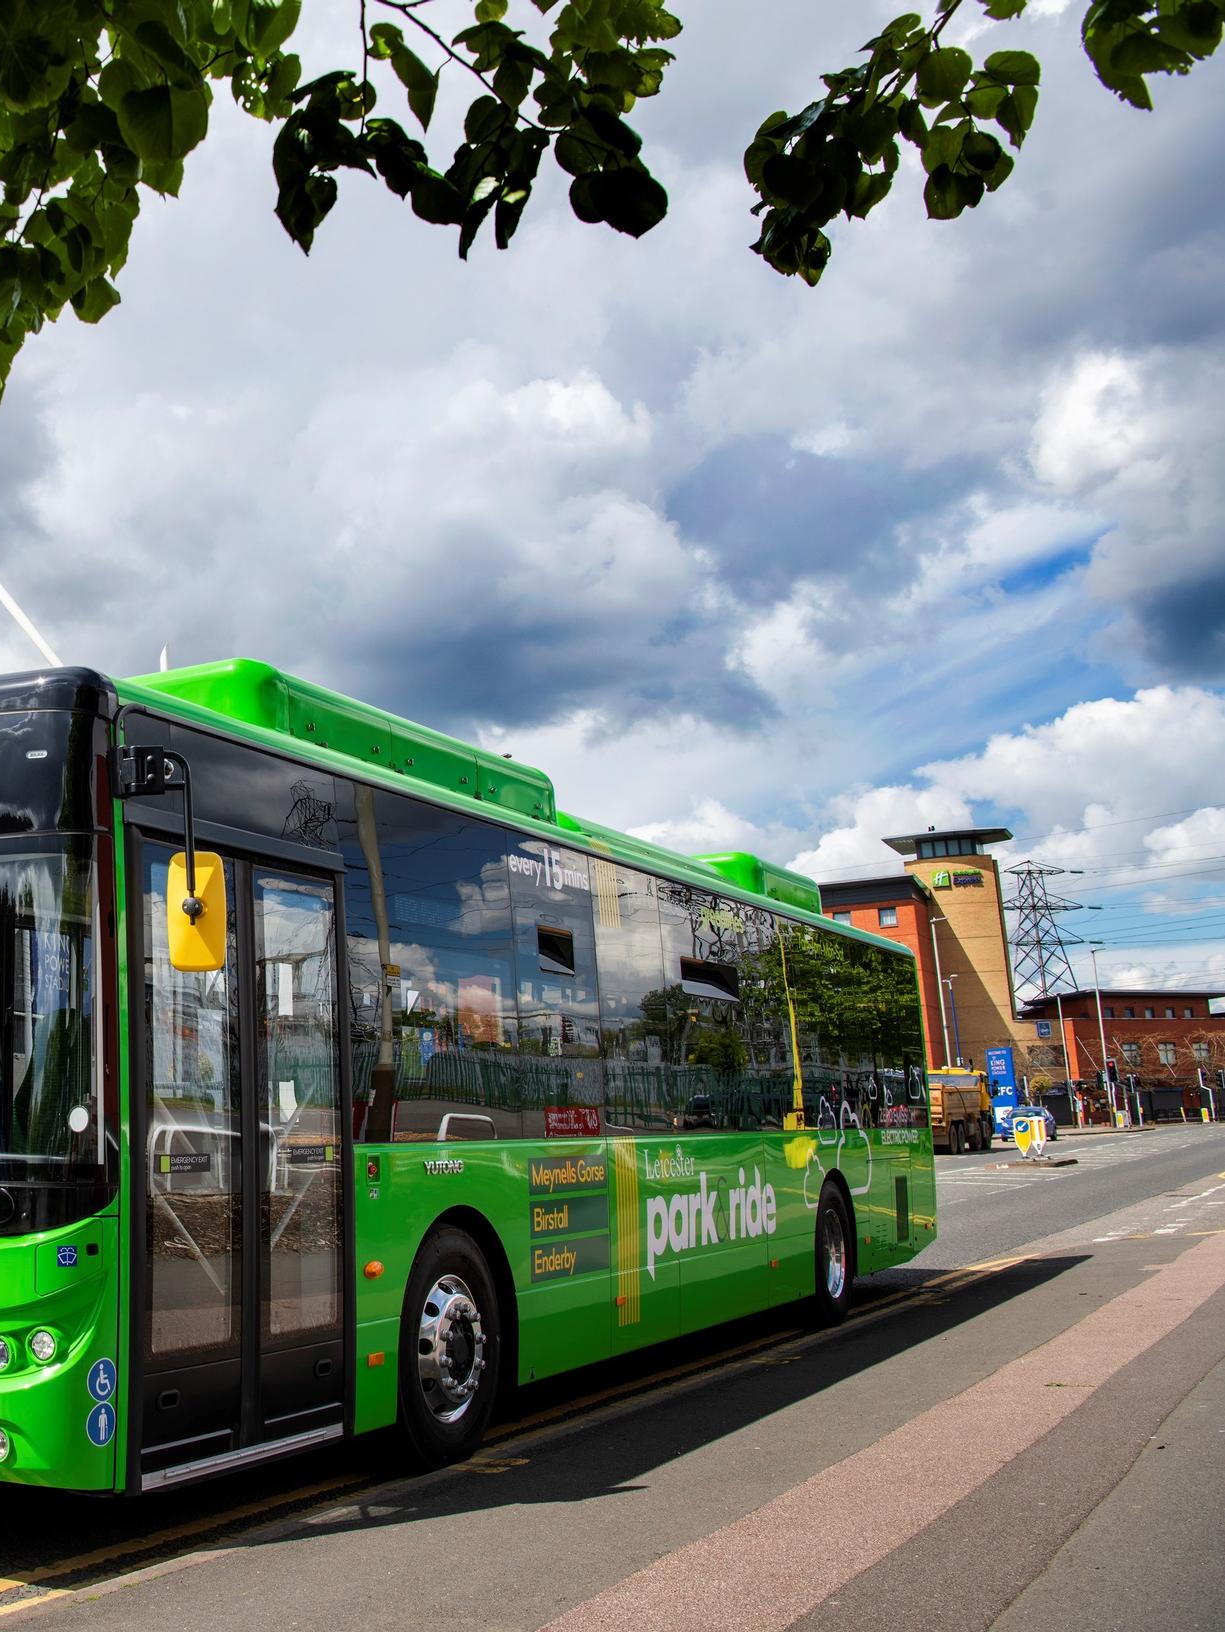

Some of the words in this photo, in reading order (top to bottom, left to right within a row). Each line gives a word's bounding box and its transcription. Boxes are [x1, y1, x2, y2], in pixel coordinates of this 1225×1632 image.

[509, 853, 542, 887] every
[543, 848, 564, 890] 15
[564, 864, 589, 891] mins
[44, 954, 70, 975] POWE
[998, 1085, 1014, 1096] FC
[424, 1160, 464, 1175] YUTONG
[531, 1161, 577, 1193] Meynells
[577, 1159, 604, 1183] Gorse
[644, 1149, 695, 1180] Leicester
[533, 1205, 569, 1232] Birstall
[534, 1245, 577, 1275] Enderby
